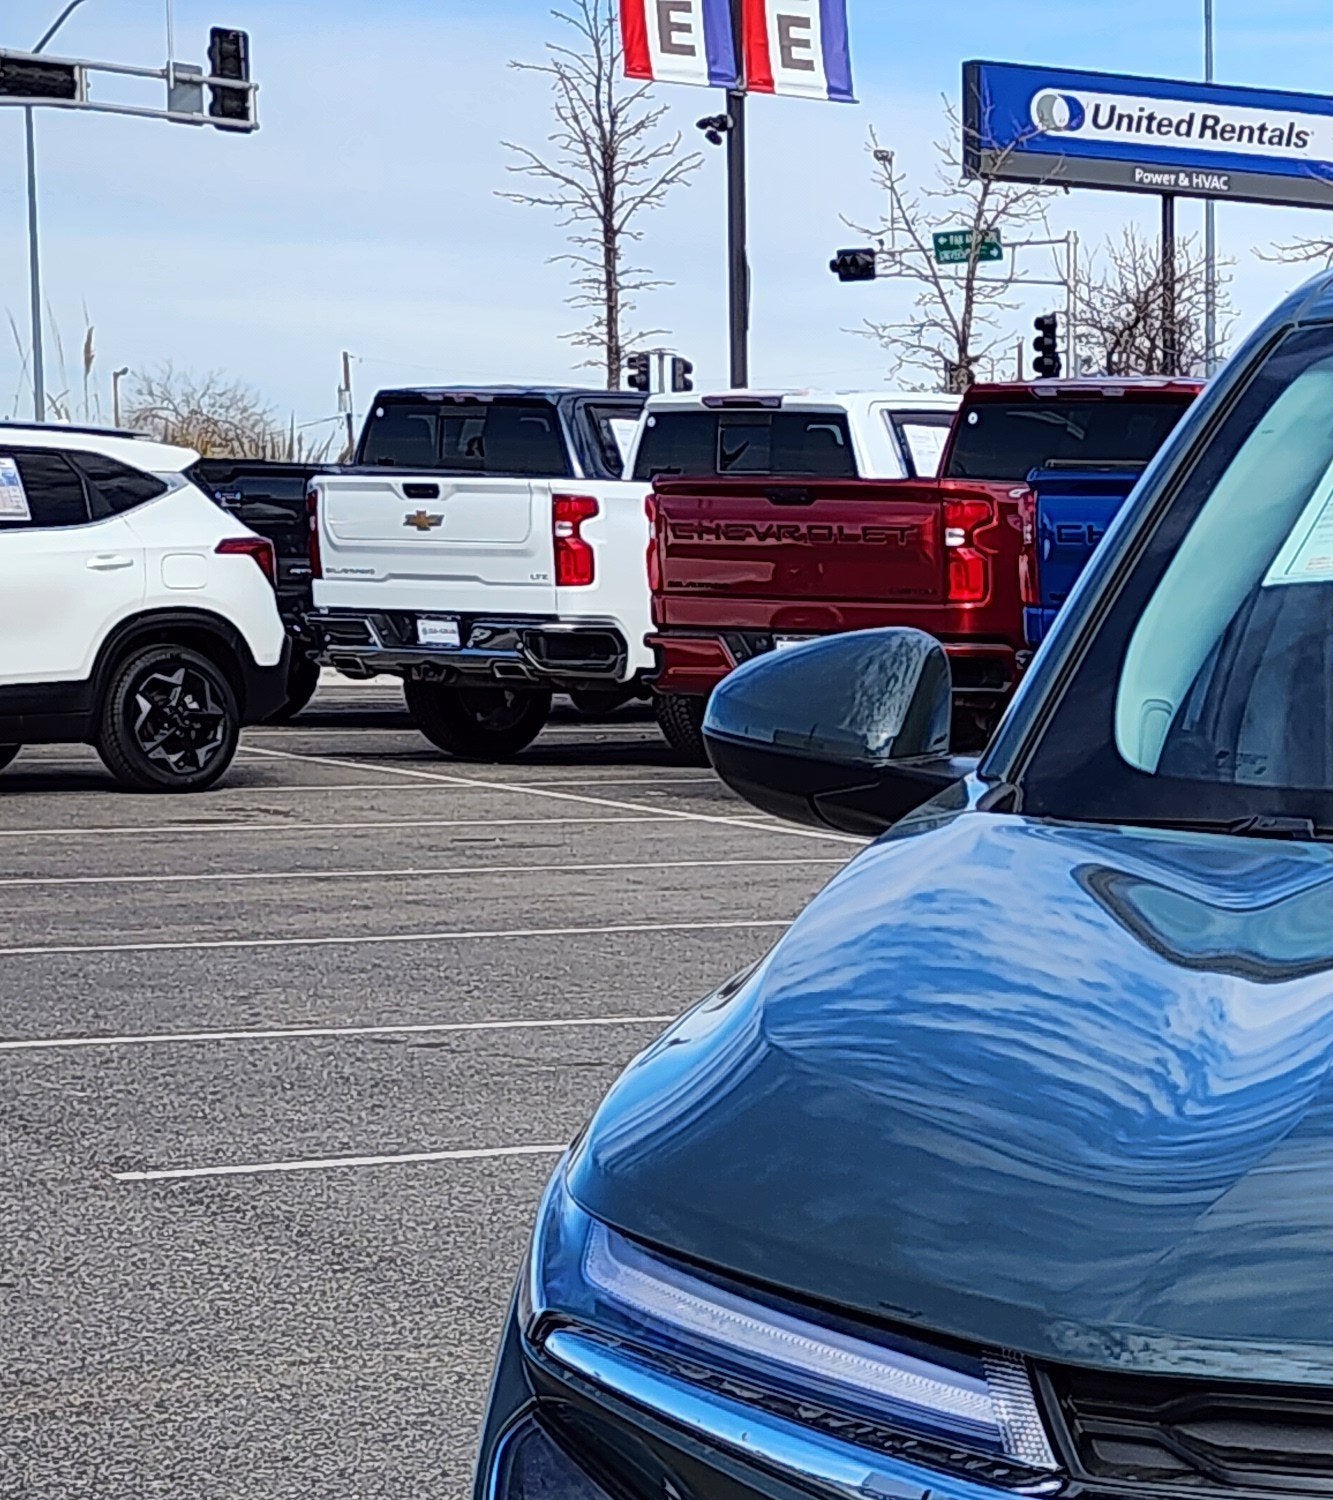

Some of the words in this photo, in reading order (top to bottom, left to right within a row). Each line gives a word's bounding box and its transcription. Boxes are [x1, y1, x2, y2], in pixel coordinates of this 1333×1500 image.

[1091, 103, 1196, 138] United
[1198, 113, 1310, 149] Rentals
[1134, 167, 1176, 186] Power
[1178, 172, 1190, 187] &
[1192, 172, 1229, 191] HVAC
[669, 521, 918, 546] CHEVROLET
